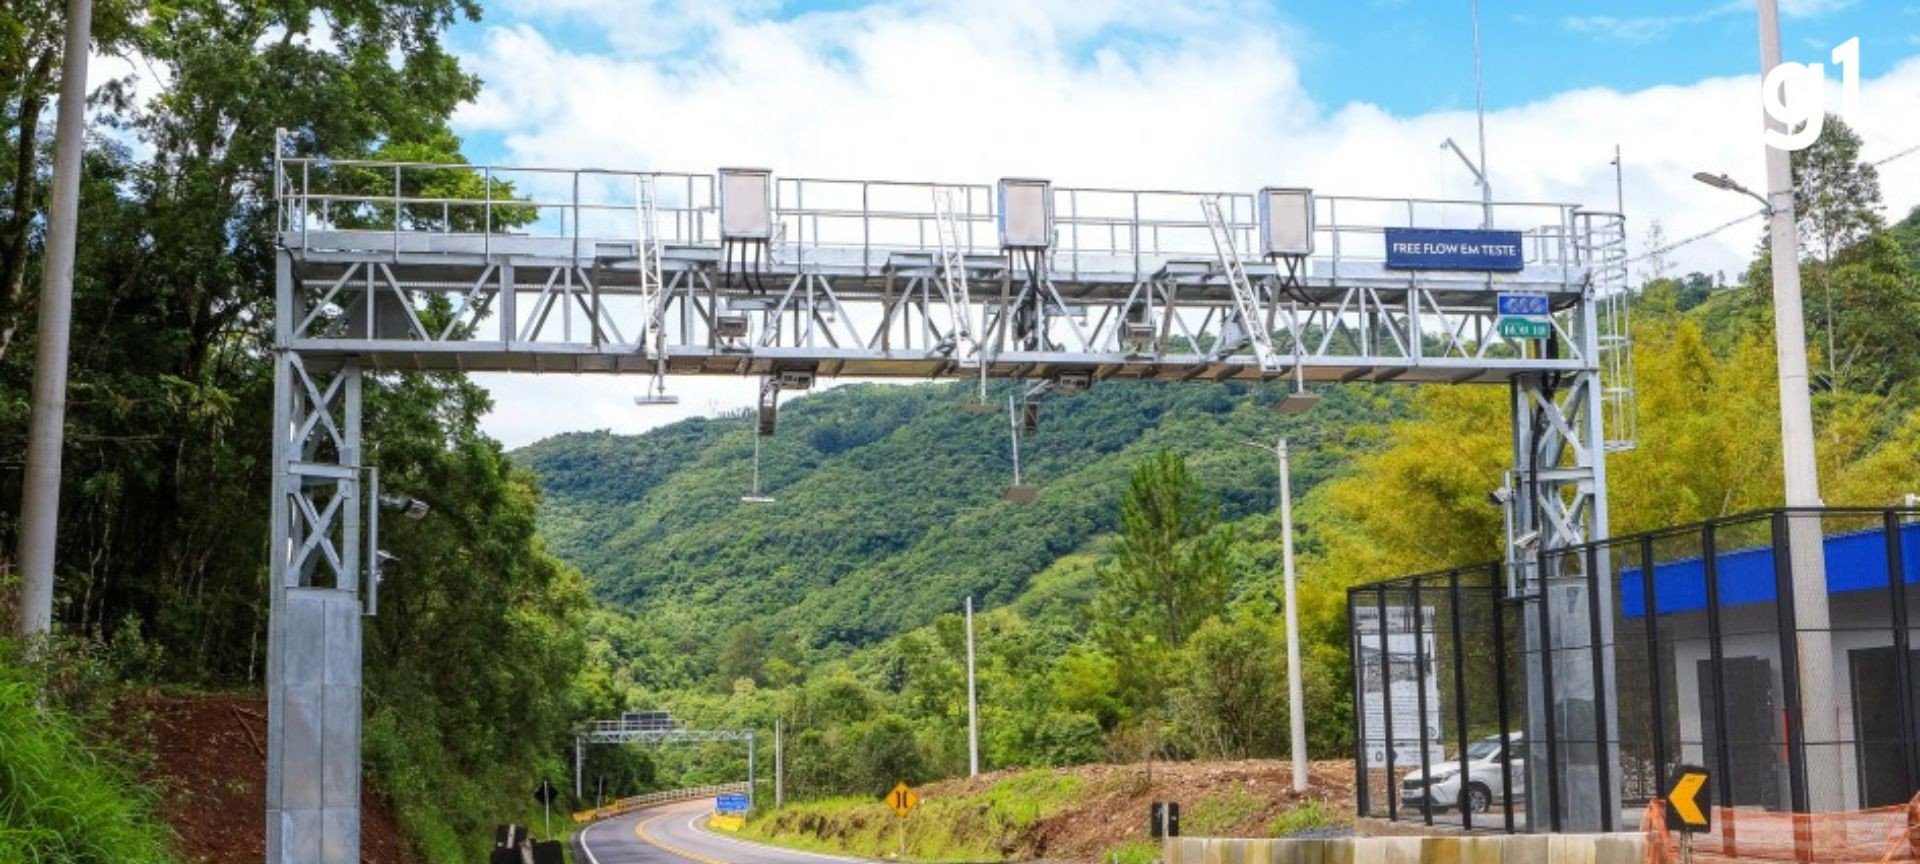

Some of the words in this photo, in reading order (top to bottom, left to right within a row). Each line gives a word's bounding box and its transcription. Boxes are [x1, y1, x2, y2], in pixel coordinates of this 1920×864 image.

[1393, 243, 1421, 254] FREE
[1424, 243, 1458, 254] FLOW
[1460, 244, 1479, 255] EM
[1481, 245, 1517, 256] TESTE
